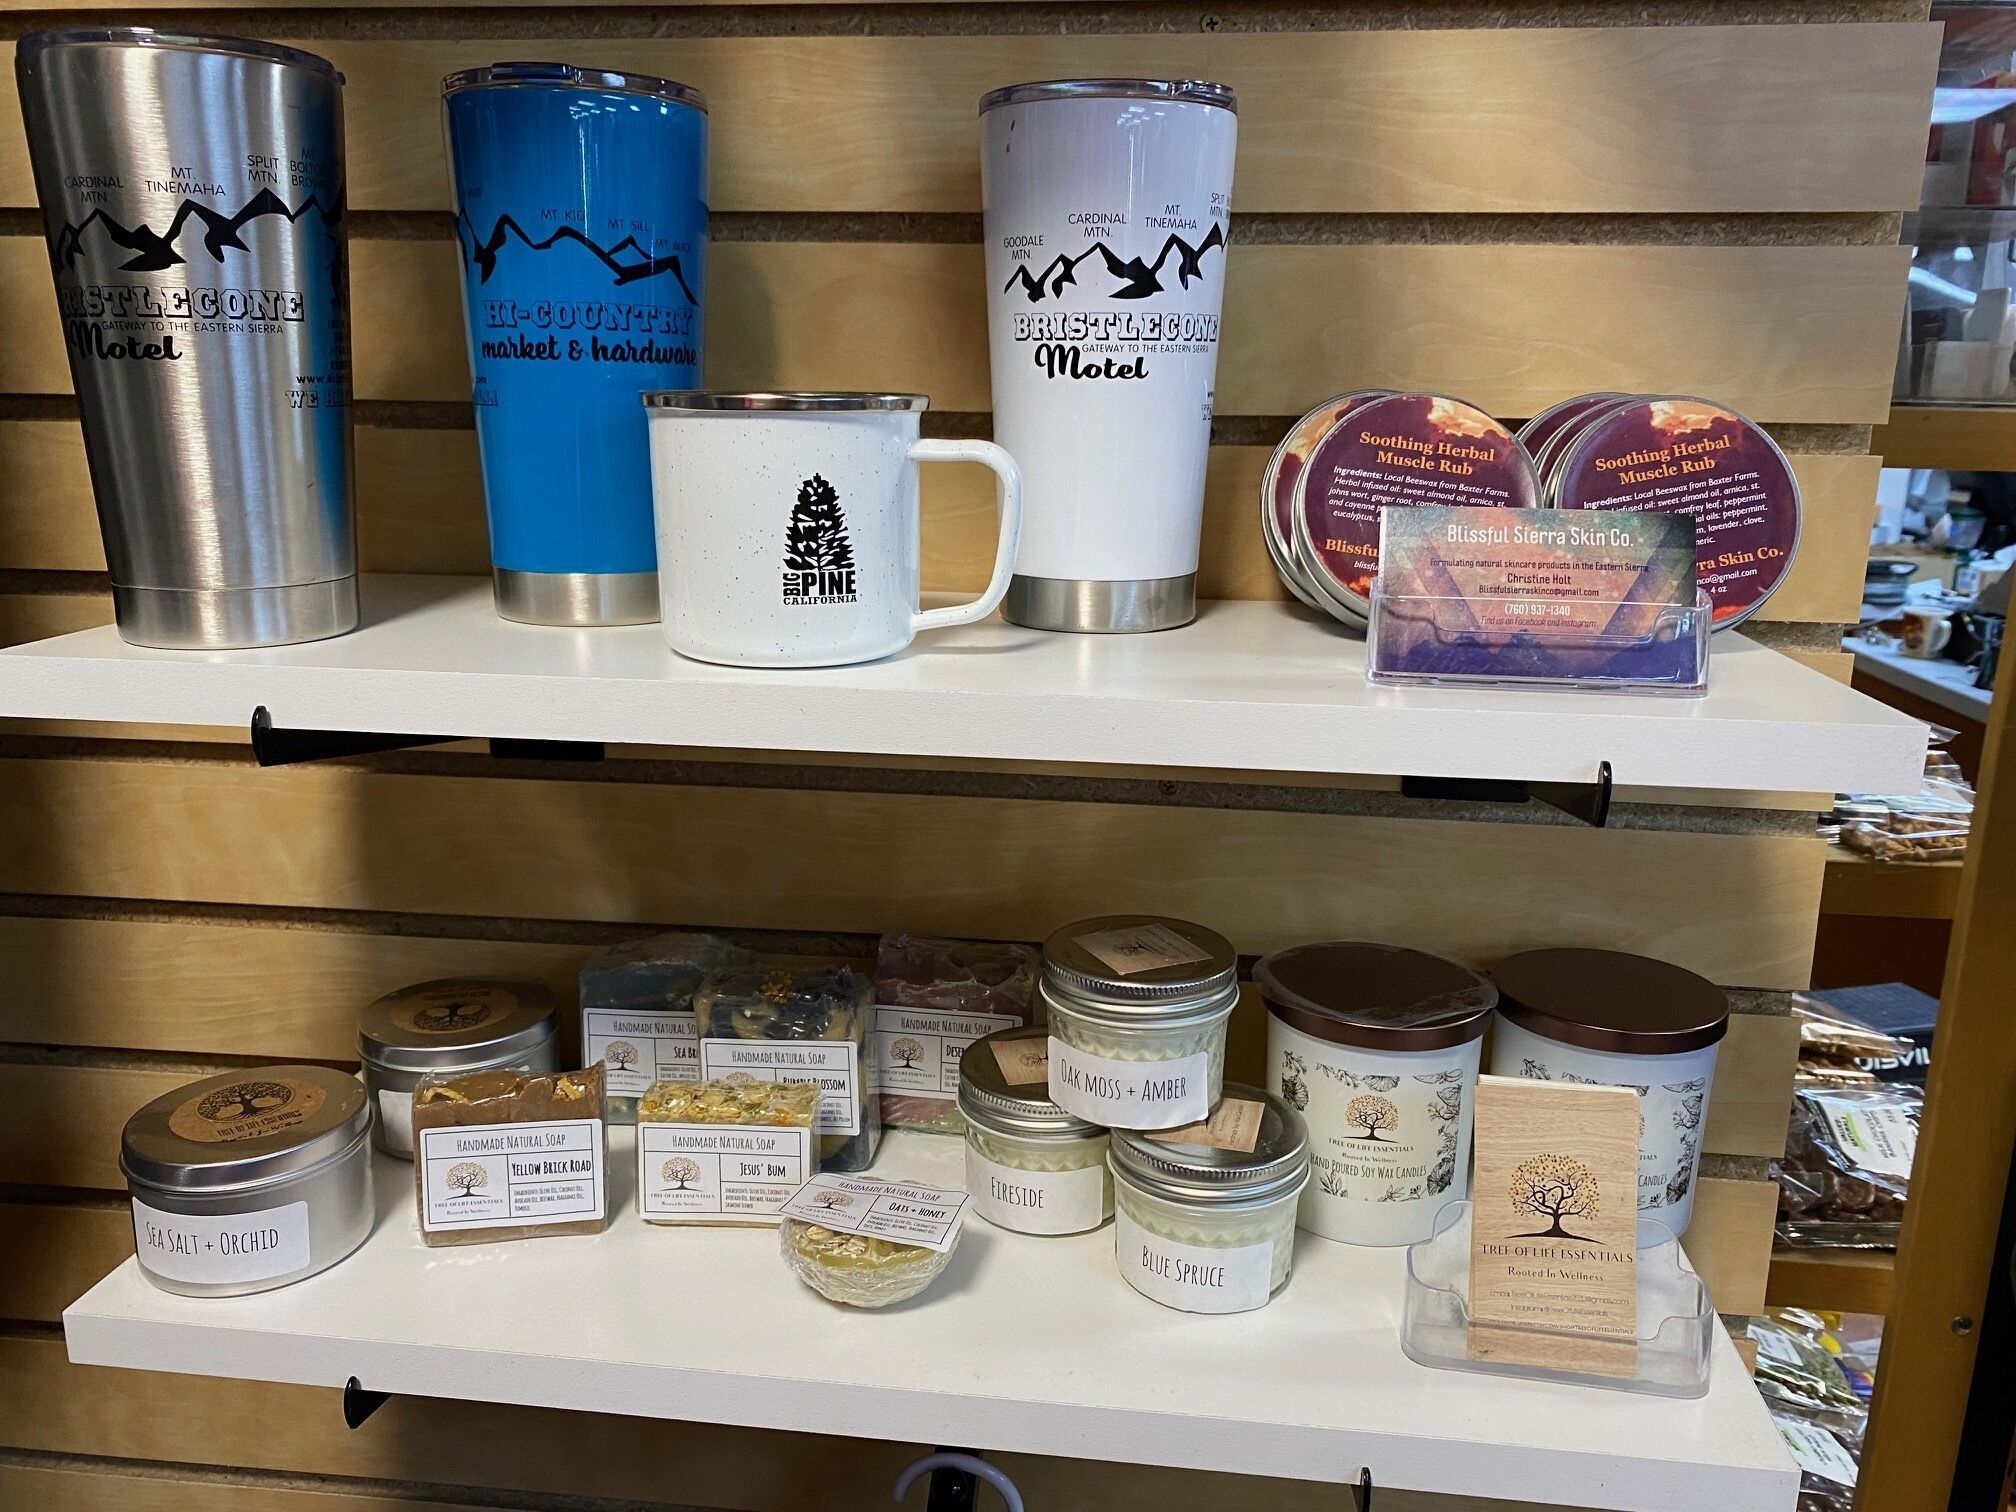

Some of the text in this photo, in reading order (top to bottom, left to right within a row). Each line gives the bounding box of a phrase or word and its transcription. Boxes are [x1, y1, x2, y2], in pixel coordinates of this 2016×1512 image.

[247, 154, 279, 170] SPLIT
[171, 166, 197, 179] MT.
[248, 169, 281, 184] MTN.
[64, 176, 124, 189] CARDINAL
[144, 179, 226, 197] TINEMAHA
[1211, 192, 1225, 205] SPLIT
[1164, 204, 1182, 216] MT.
[1068, 213, 1127, 225] CARDINAL
[1145, 217, 1198, 230] TINEMAHA
[1083, 227, 1114, 238] MTN.
[1003, 235, 1044, 249] GOODALE
[1011, 248, 1033, 261] MTN.
[484, 300, 693, 335] HI-COUNTRY
[101, 321, 284, 335] GATEWAY TO THE EASTERN SIERRA
[1013, 312, 1219, 342] BRISTLECONE
[67, 319, 183, 361] Motel
[481, 333, 698, 368] market & hardware
[1082, 344, 1209, 354] GATEWAY TO THE EASTERN SIERRA
[1034, 343, 1150, 380] Motel
[1359, 431, 1495, 463] Soothing Herbal
[1595, 434, 1731, 472] Soothing Herbal
[1377, 451, 1473, 476] Muscle Rub
[1618, 456, 1716, 486] Muscle Rub
[1333, 466, 1510, 498] Ingredients: Local Beeswax from Baxter Farms.
[1334, 476, 1360, 487] Herbal
[1361, 481, 1389, 491] infused
[1403, 488, 1425, 496] sweet
[1426, 490, 1456, 501] almond
[1327, 487, 1349, 497] johns
[1583, 471, 1760, 510] Ingredients: Local Beeswax from Baxter Farms.
[1328, 499, 1375, 511] and cayenne
[1657, 491, 1708, 507] sweet almond
[1724, 492, 1767, 508] peppermint
[1447, 524, 1634, 547] Blissful Sierra Skin Co.
[1430, 558, 1649, 572] Formulating natural skincare products in the Eastern Sierra
[1718, 546, 1784, 569] Skin Co.
[783, 572, 801, 596] BIG
[801, 570, 857, 597] PINE
[1507, 572, 1571, 585] Christine Holt
[1710, 586, 1716, 594] 4
[783, 595, 857, 605] CALIFORNIA
[1504, 603, 1571, 616] (760) 937-1340
[1481, 615, 1597, 629] Find us on Facebook and Instagram
[674, 1046, 686, 1059] SEA
[732, 1050, 826, 1065] HANDMADE NATURAL SOAP
[1060, 1057, 1187, 1103] OAK MOSS + AMBER
[456, 1132, 566, 1152] HANDMADE NATURAL SOAP
[672, 1135, 776, 1151] HANDMADE NATURAL SOAP
[1328, 1137, 1414, 1153] TREE OF LIFE ESSENTIALS
[511, 1158, 592, 1177] YELLOW BRICK ROAD
[767, 1163, 786, 1178] BUM
[1310, 1152, 1427, 1180] HAND POURED SOY WAX CANDLES
[1638, 1173, 1668, 1187] CANDLES
[837, 1181, 942, 1202] HANDMADE NATURAL SOAP
[990, 1174, 1045, 1210] FIRESIDE
[888, 1201, 910, 1213] OATS
[918, 1208, 947, 1219] HONEY
[146, 1220, 280, 1257] SEA SALT + ORCHID
[1483, 1244, 1634, 1263] TREE OF LIFE ESSENTIALS
[1141, 1243, 1225, 1288] BLUE SPRUCE
[1508, 1265, 1604, 1282] Rooted In Wellness
